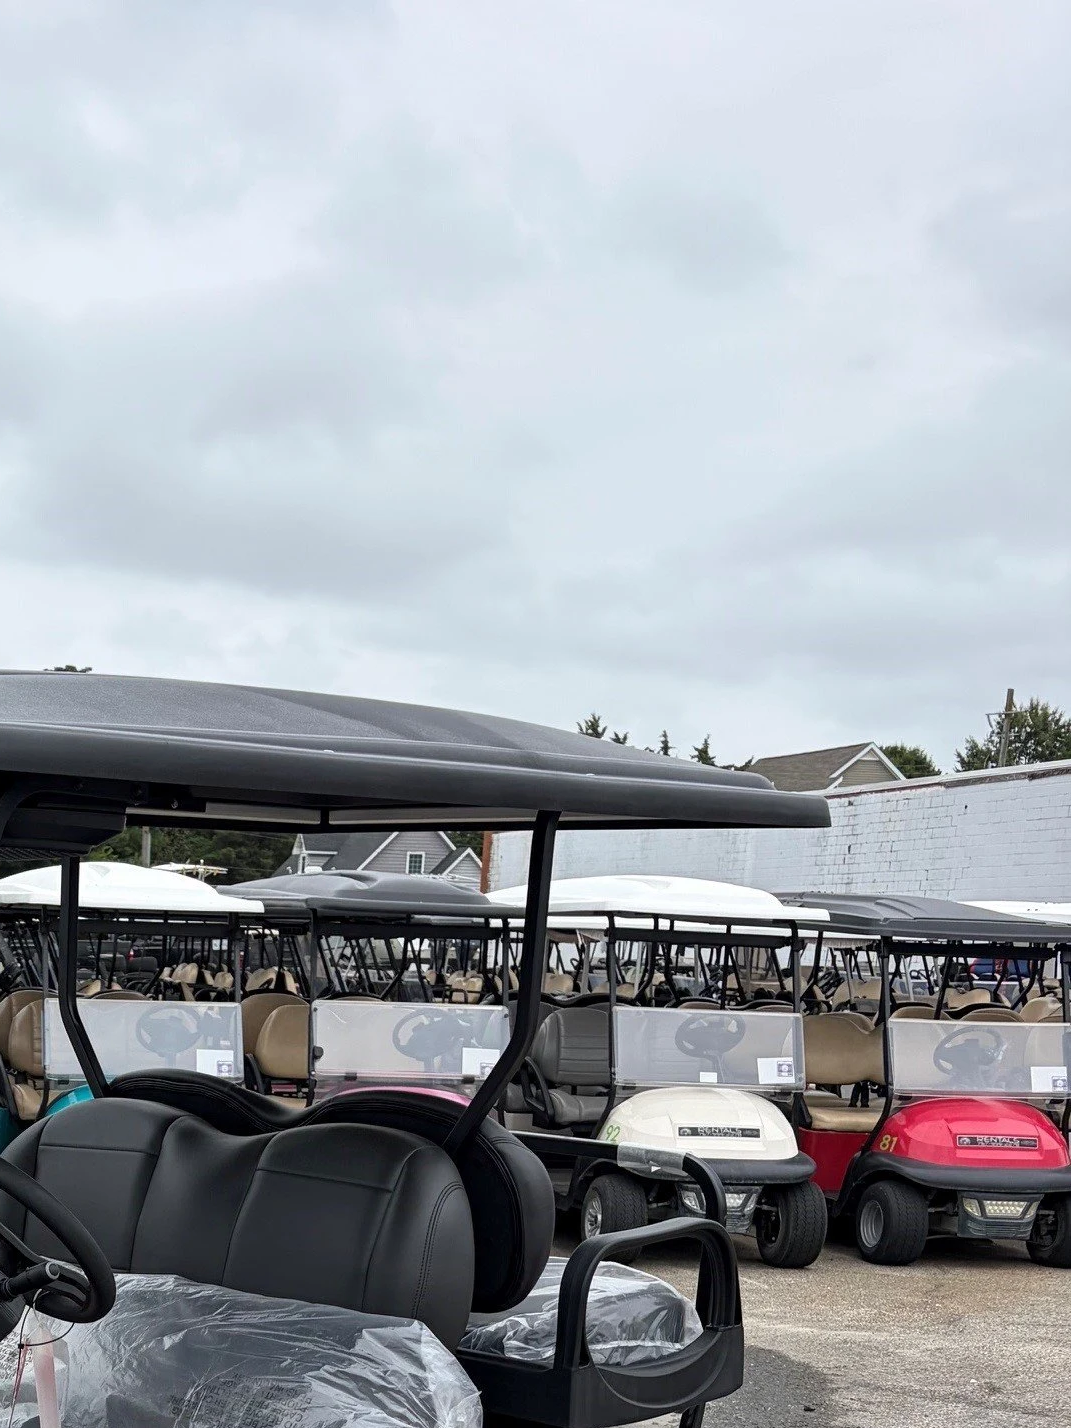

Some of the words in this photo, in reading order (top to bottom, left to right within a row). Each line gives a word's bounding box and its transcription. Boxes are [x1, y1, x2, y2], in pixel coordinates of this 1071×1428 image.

[606, 1125, 621, 1142] 92
[976, 1136, 1020, 1144] RENTALS
[880, 1135, 898, 1152] 81
